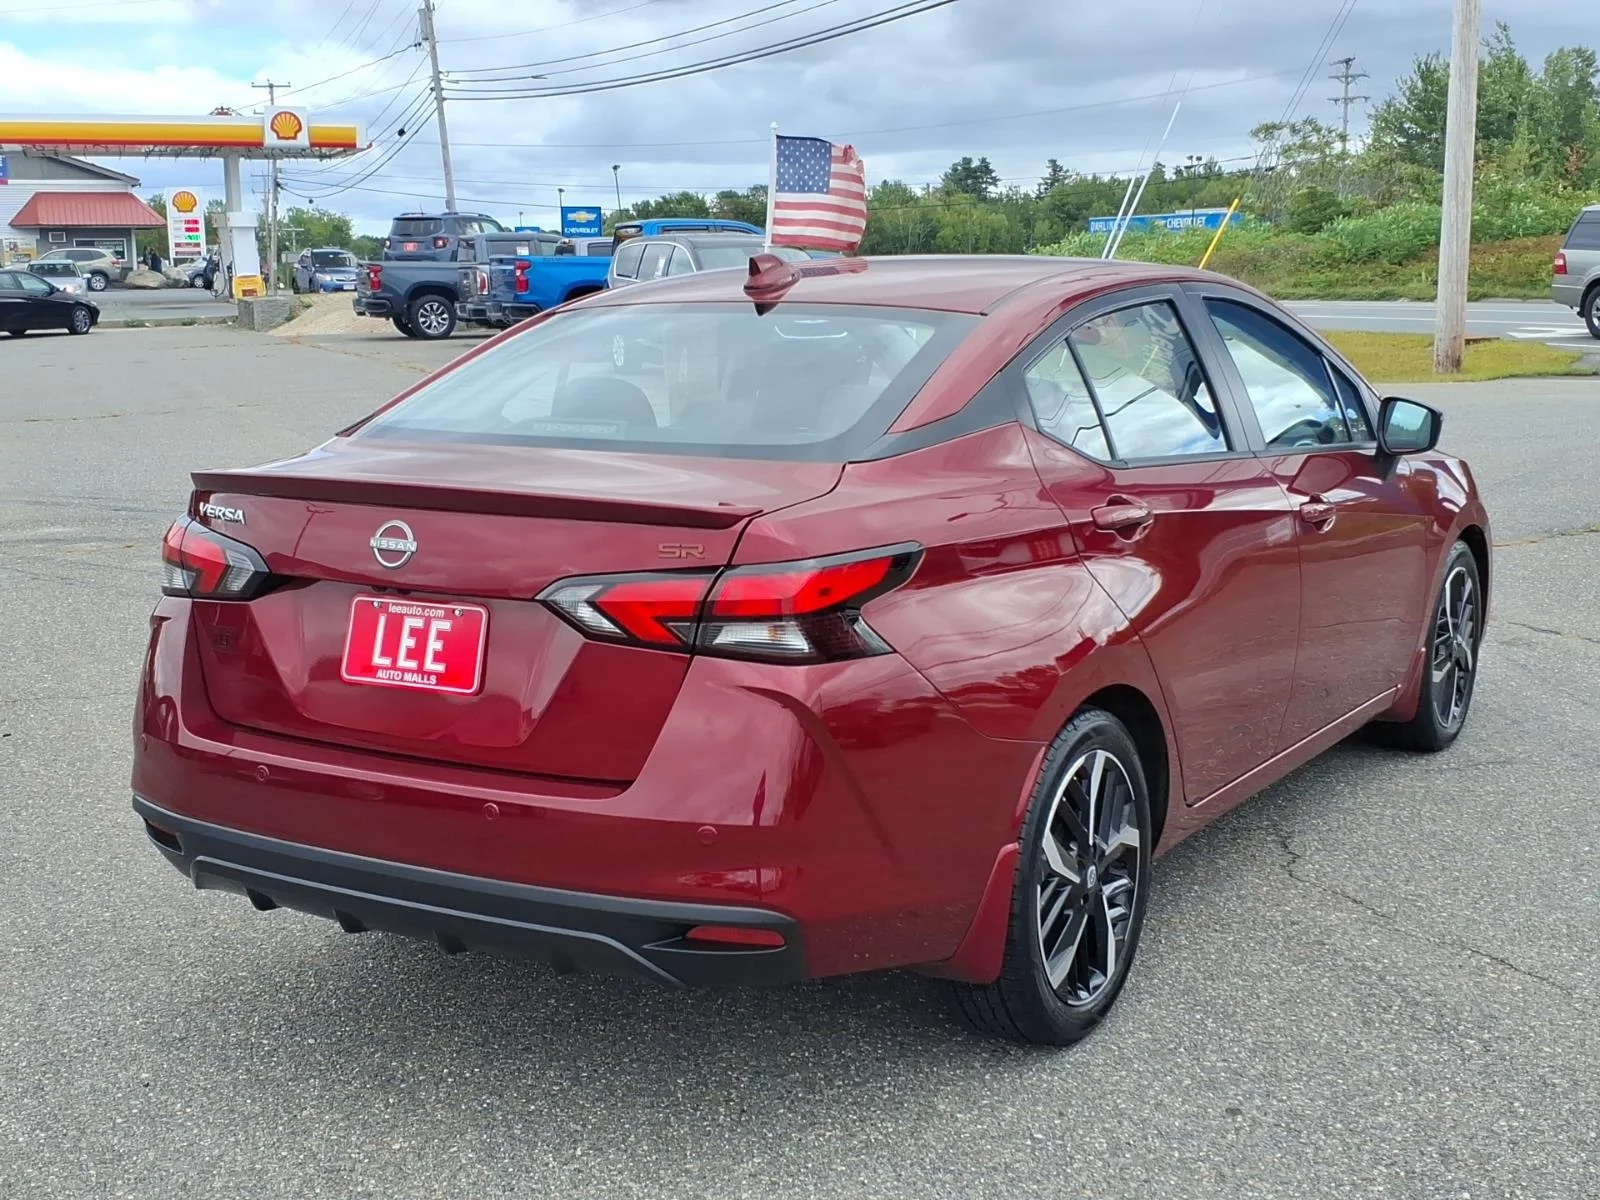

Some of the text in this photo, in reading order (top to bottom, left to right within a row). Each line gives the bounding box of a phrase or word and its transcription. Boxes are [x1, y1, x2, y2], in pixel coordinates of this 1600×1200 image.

[199, 501, 246, 525] VERSA
[370, 537, 417, 552] NISSAN
[658, 543, 705, 560] SR
[388, 602, 445, 618] leeauto.com
[371, 613, 453, 674] LEE
[375, 668, 438, 686] AUTO MALLS
